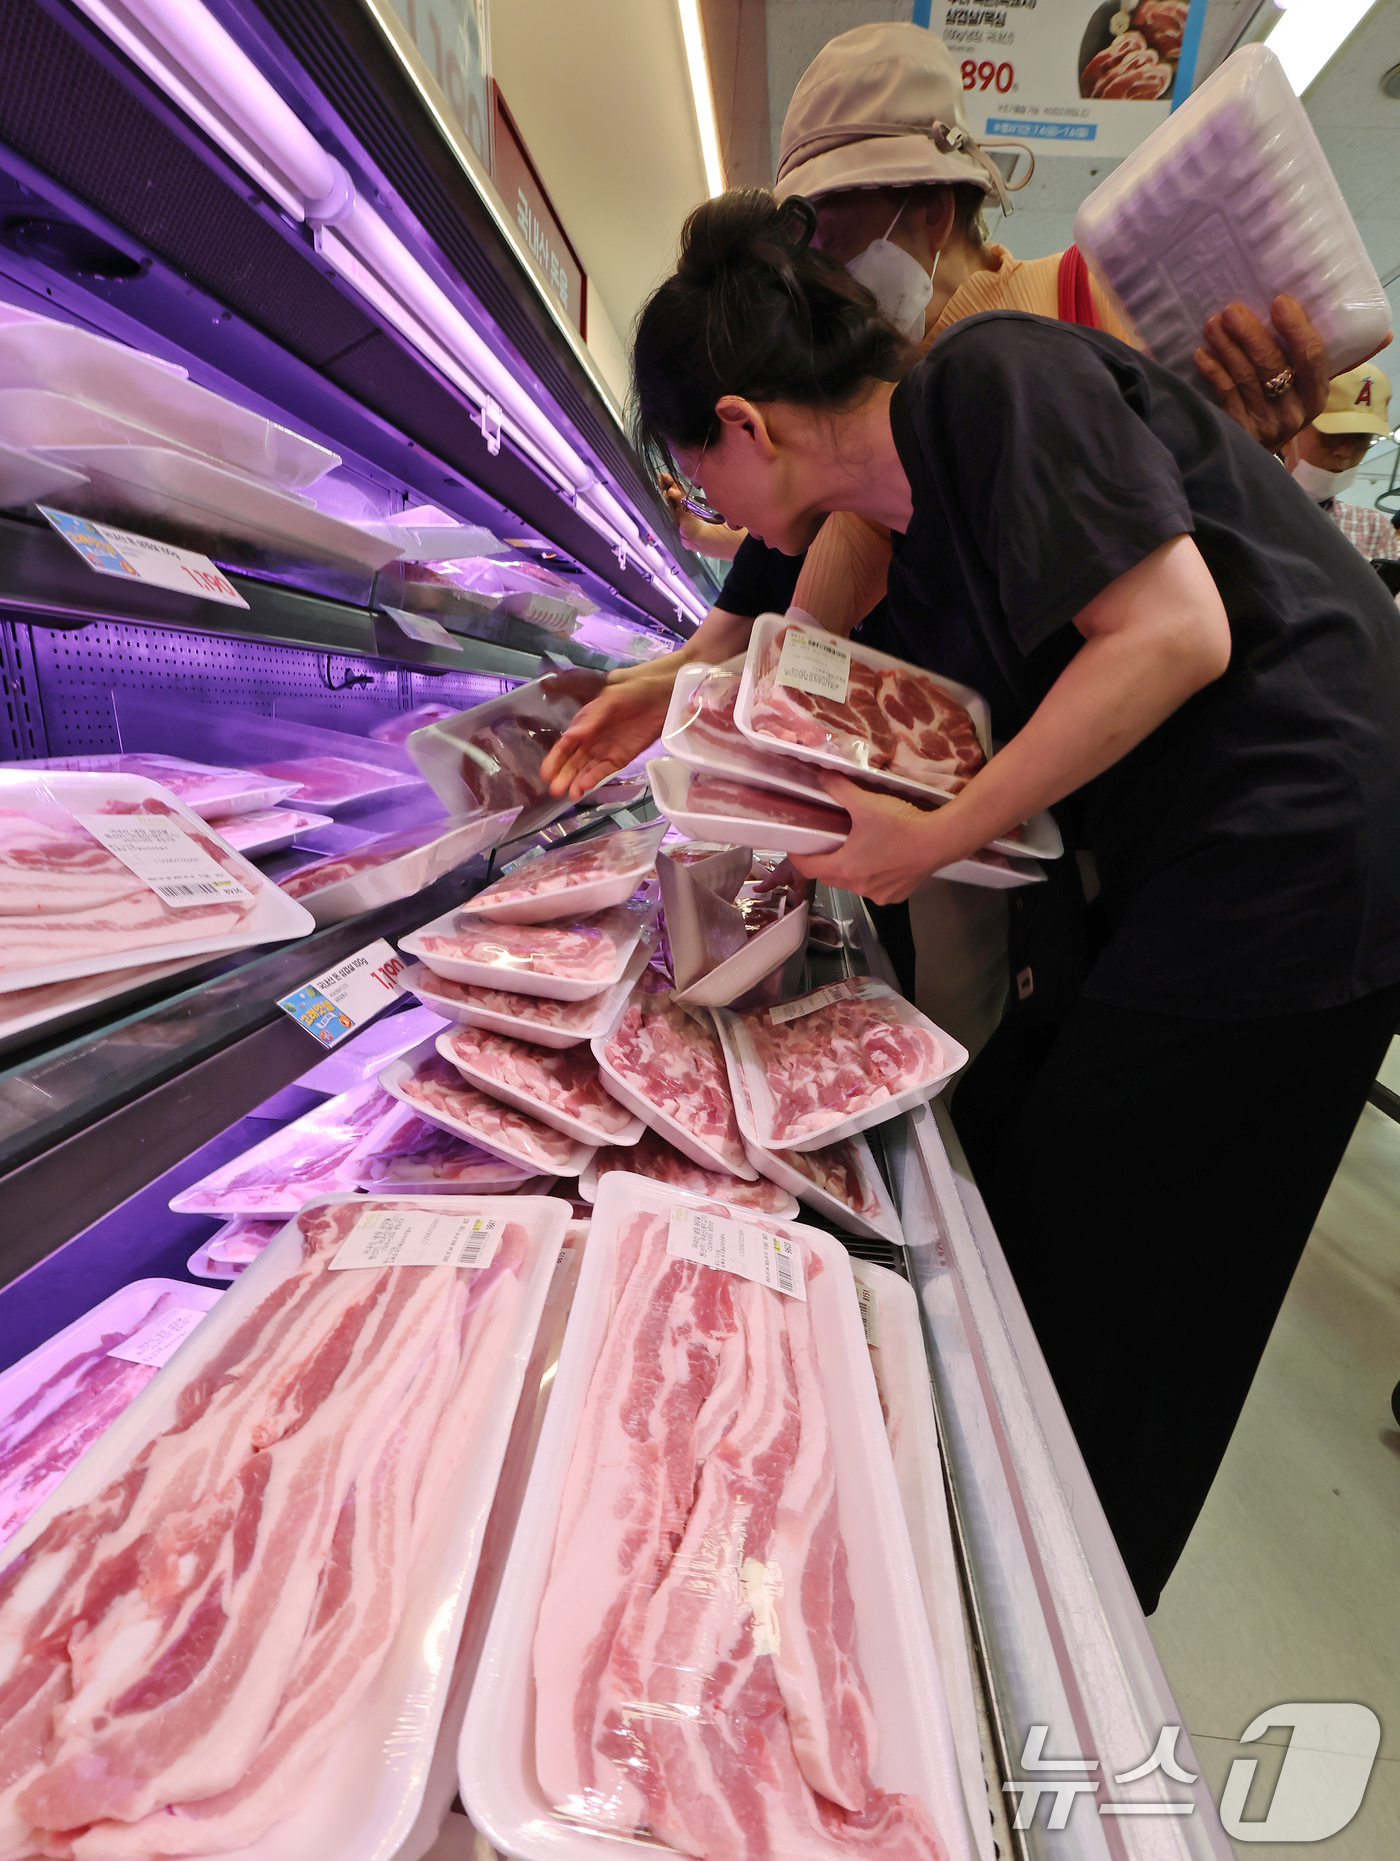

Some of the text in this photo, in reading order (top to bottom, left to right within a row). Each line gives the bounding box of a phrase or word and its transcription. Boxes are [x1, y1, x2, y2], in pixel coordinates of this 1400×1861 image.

[516, 186, 549, 271] 국내산
[1354, 379, 1372, 407] A
[180, 565, 236, 598] 1,190
[317, 957, 369, 990] 국내산 돈 삼겹살 100g
[783, 1241, 793, 1254] 9603
